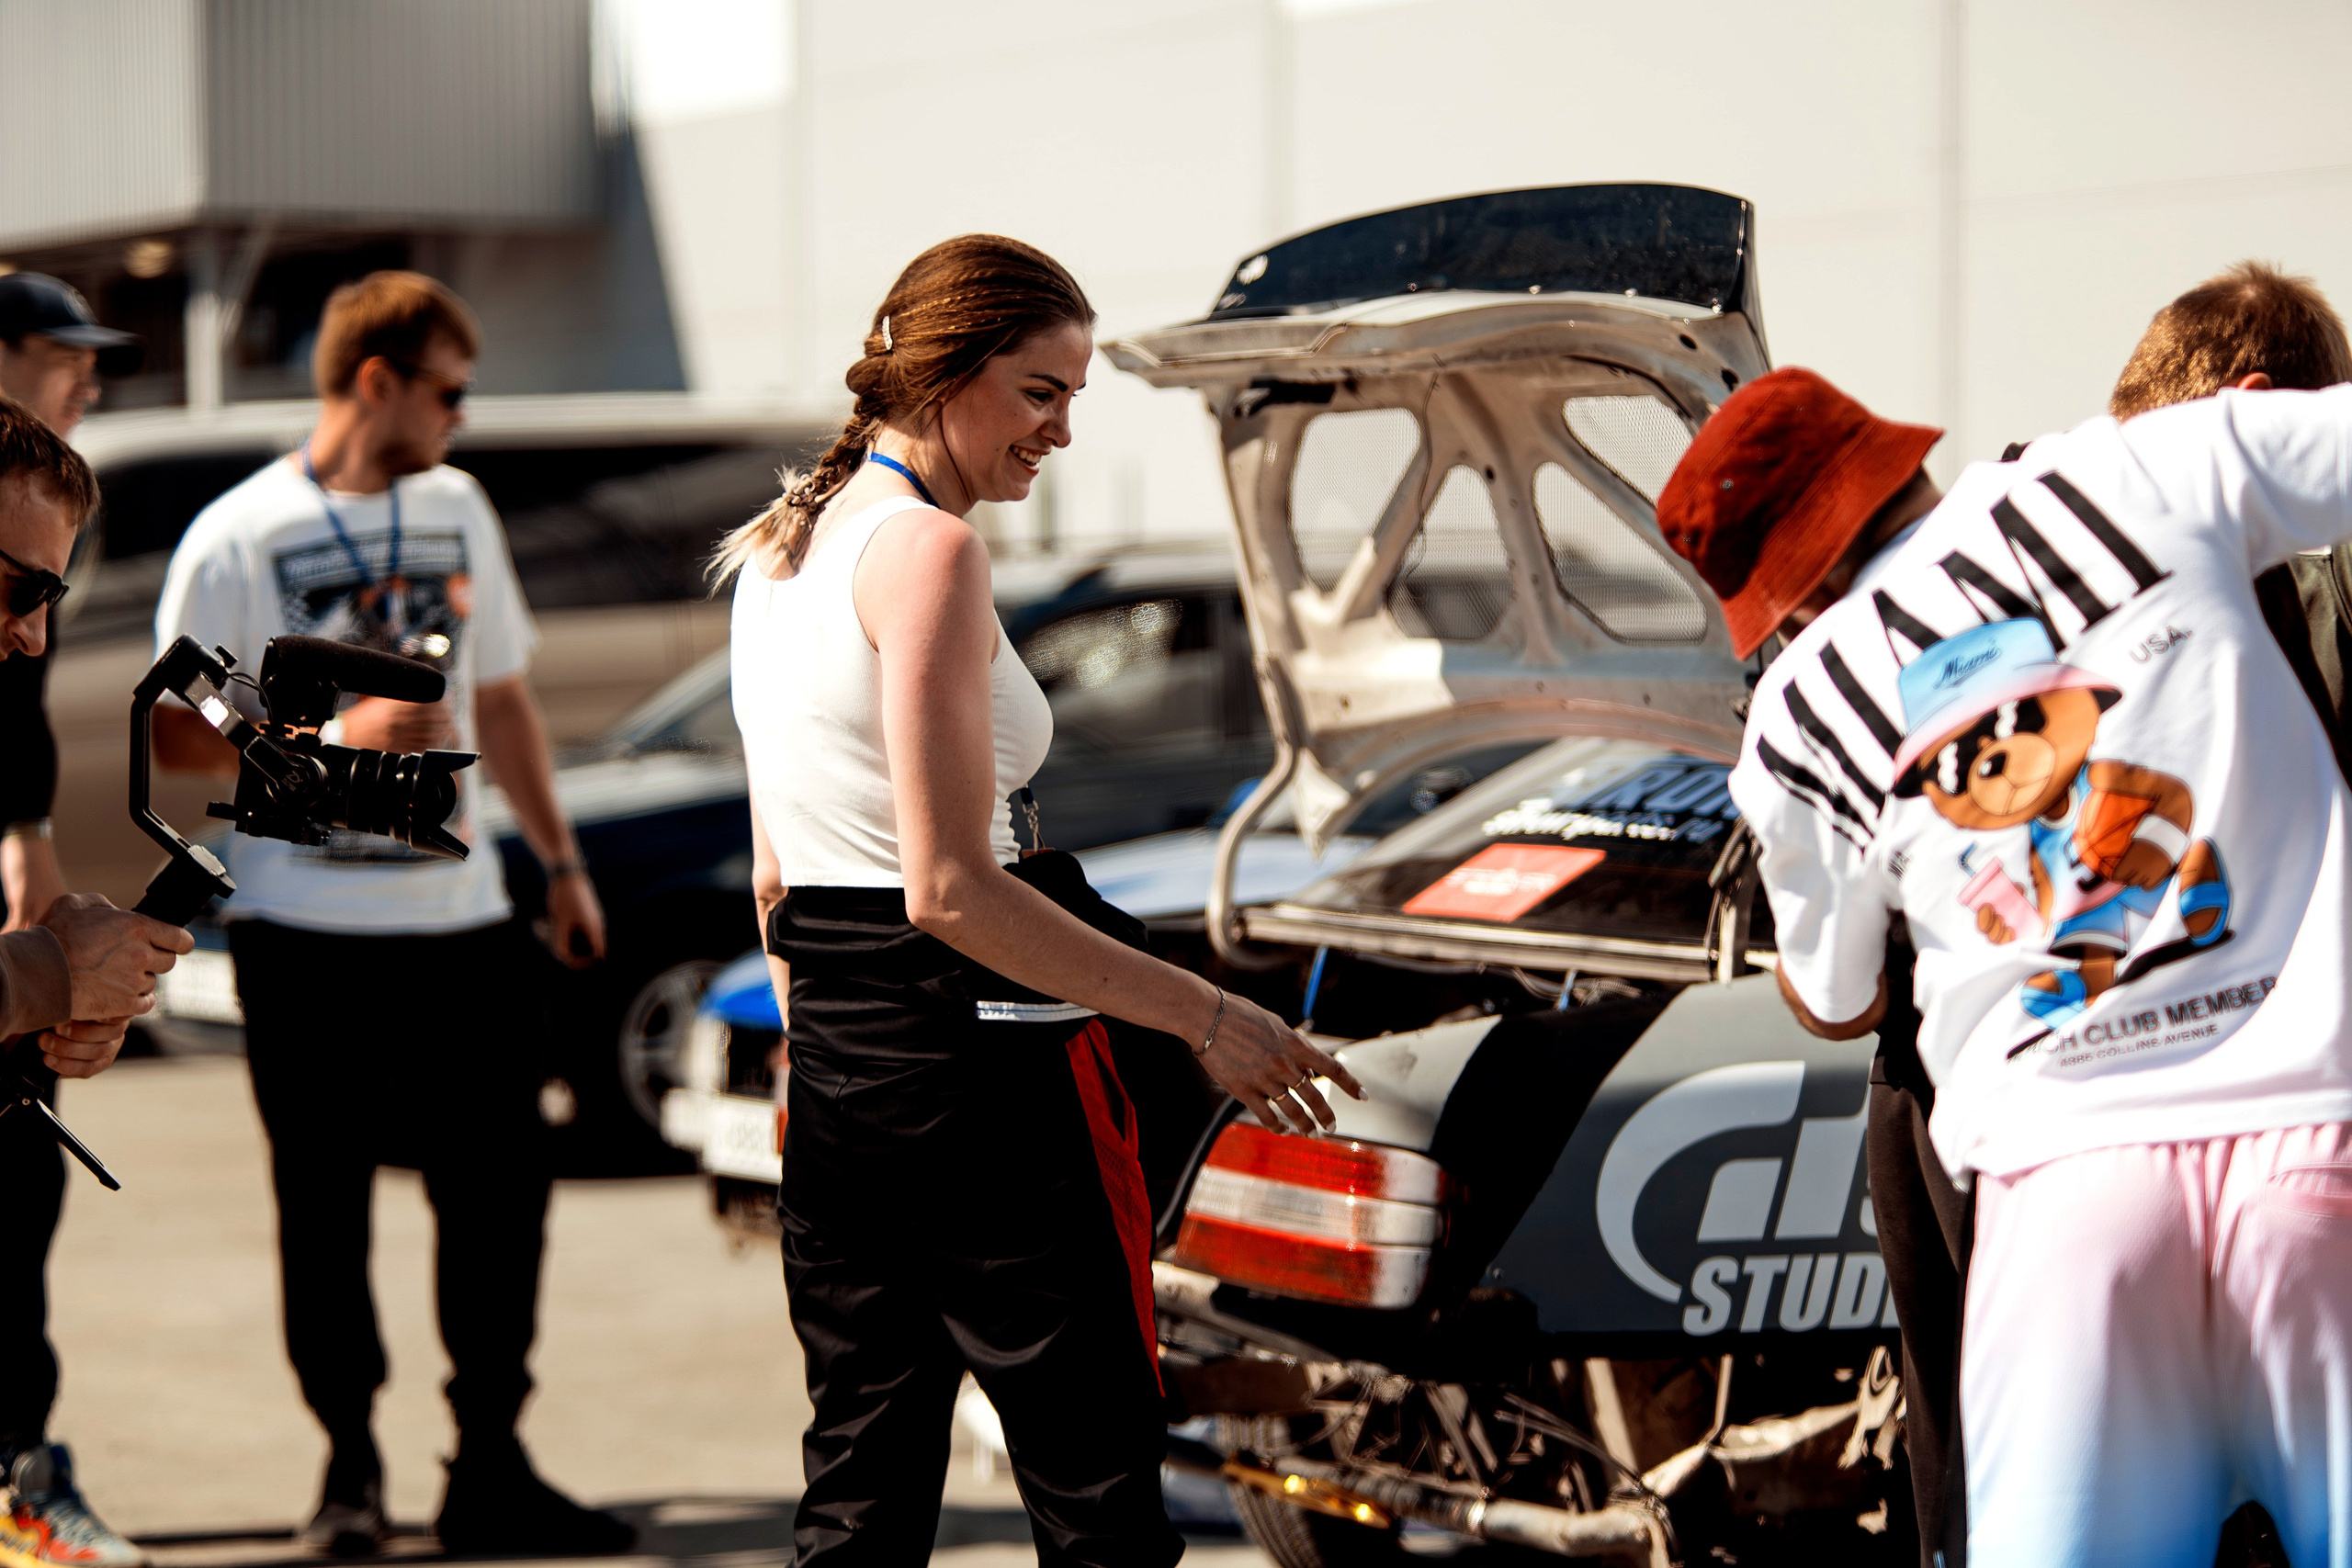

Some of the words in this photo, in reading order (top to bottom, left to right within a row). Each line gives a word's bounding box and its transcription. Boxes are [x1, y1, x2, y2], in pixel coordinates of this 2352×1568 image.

[1755, 467, 2174, 847] MIAMI
[1933, 637, 2001, 689] Miami
[2084, 1009, 2161, 1045] CLUB
[2096, 1037, 2160, 1059] COLLINS
[2164, 1023, 2220, 1045] AVENUE
